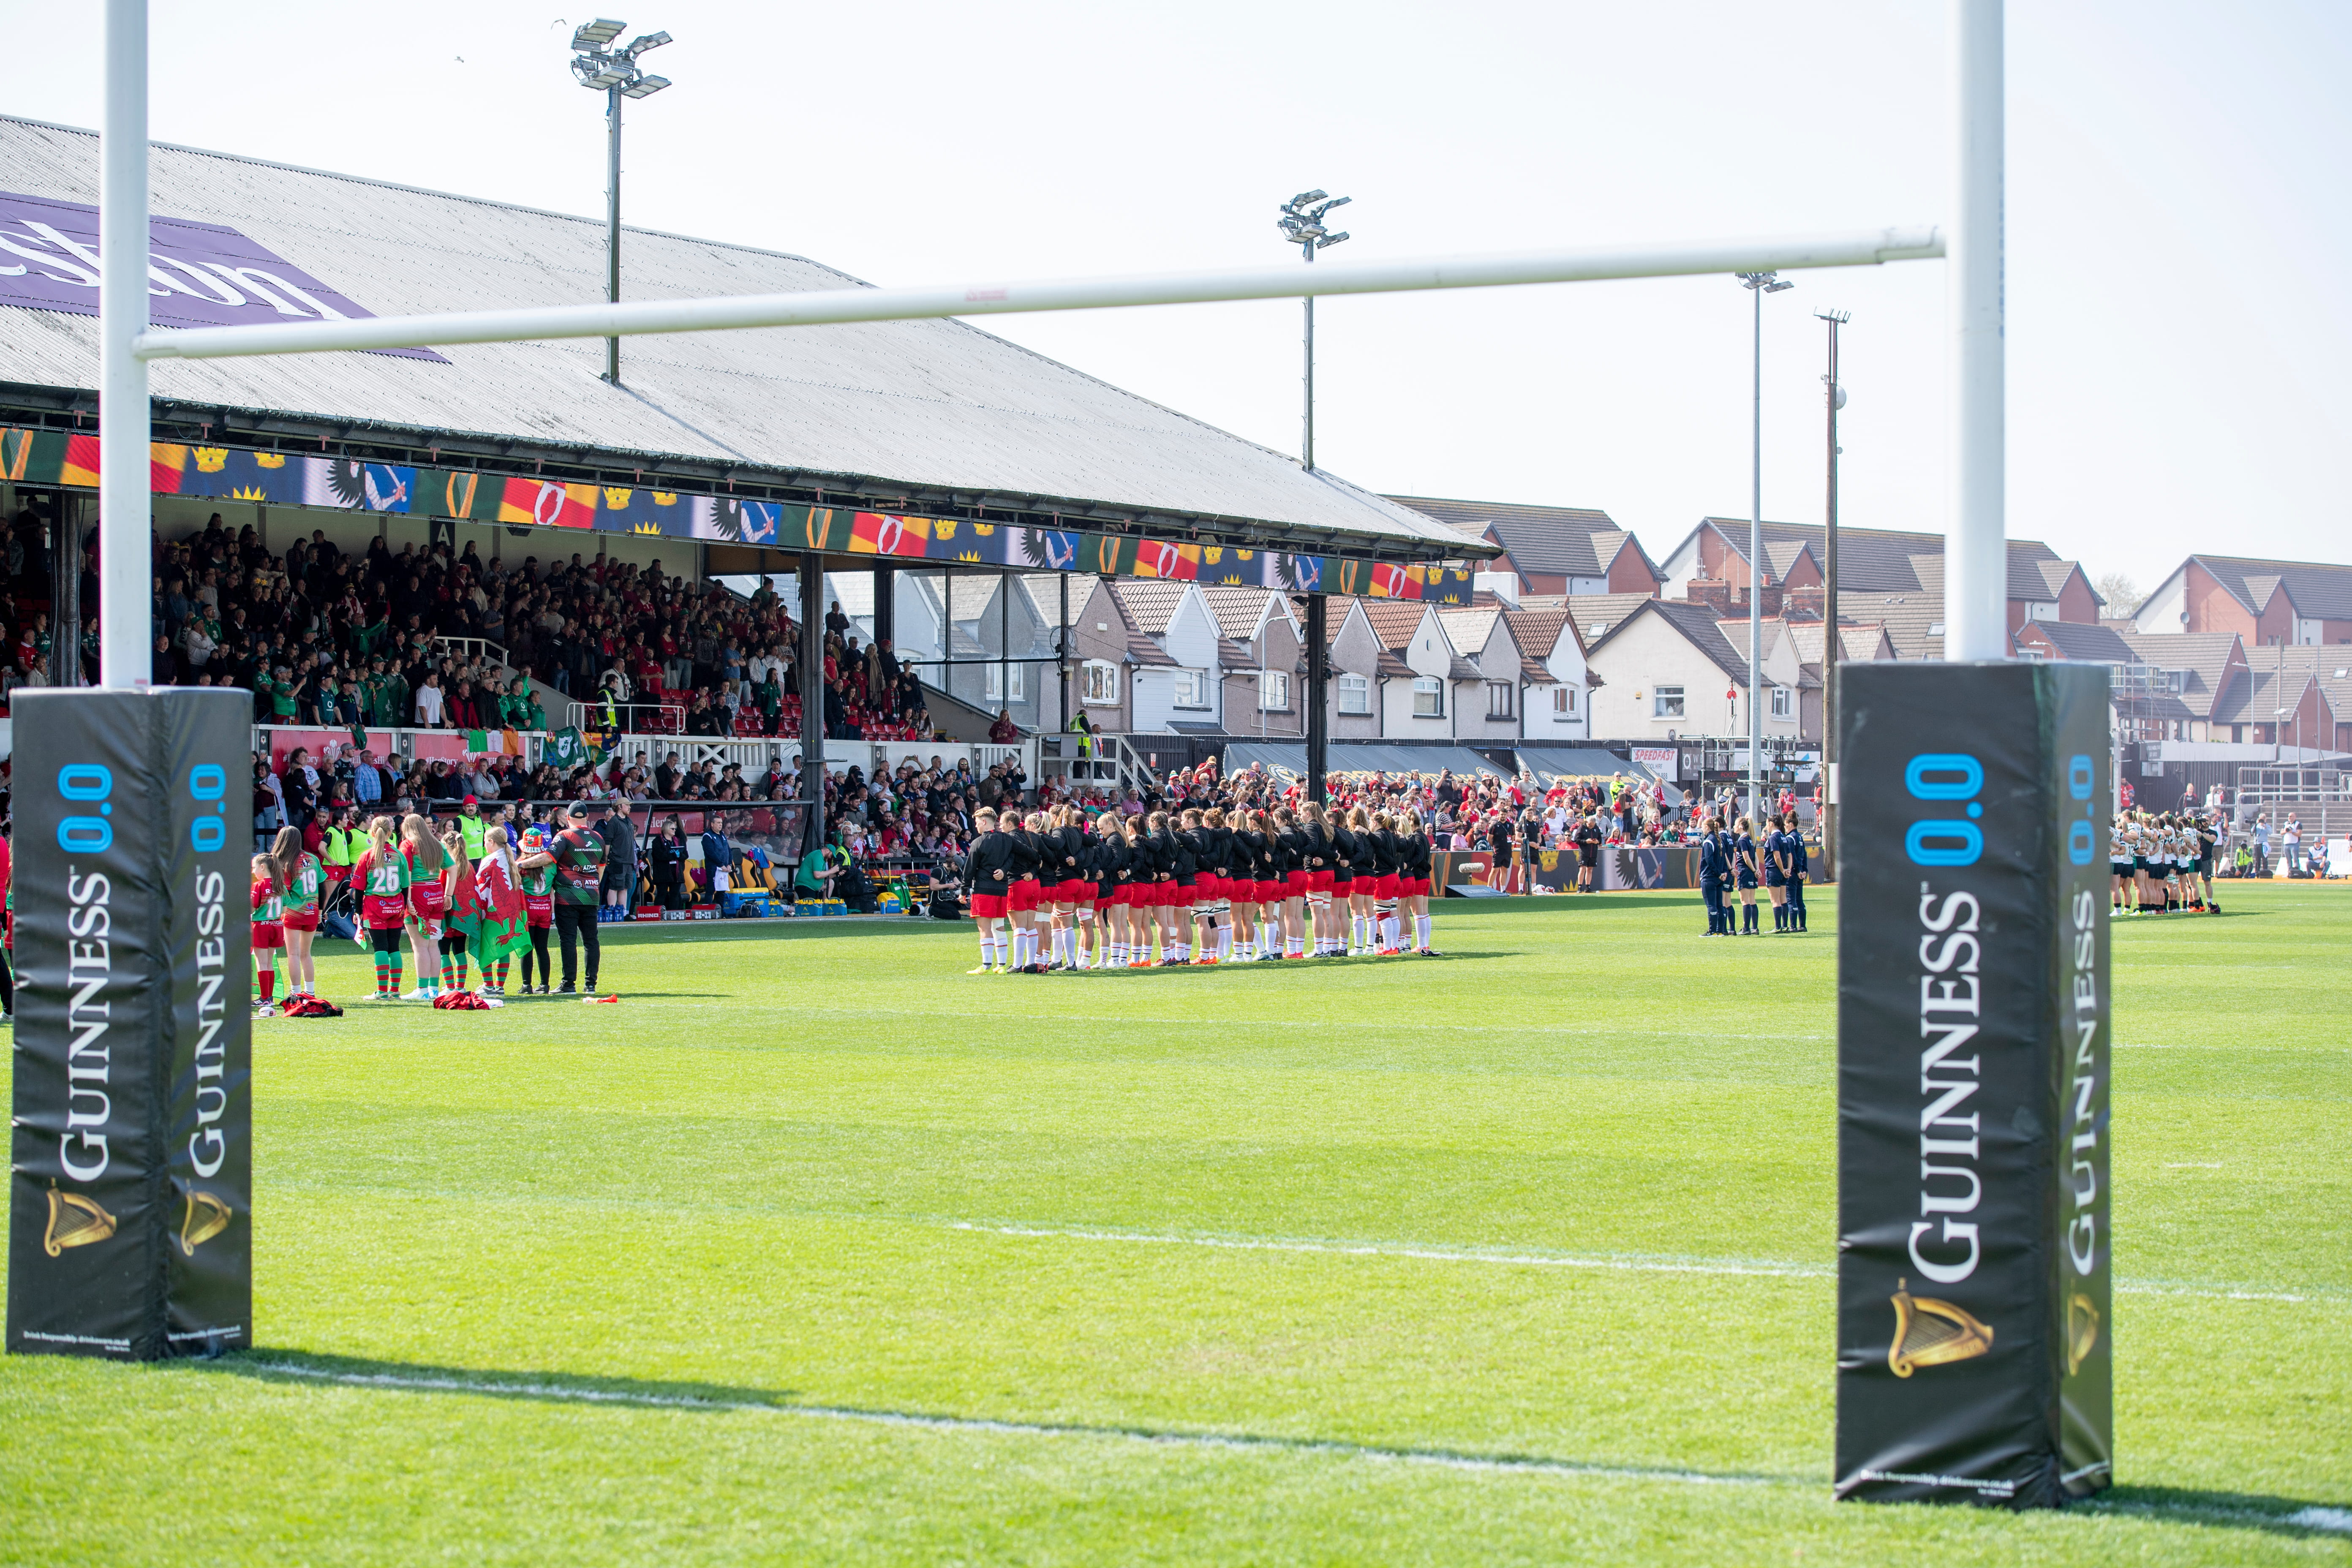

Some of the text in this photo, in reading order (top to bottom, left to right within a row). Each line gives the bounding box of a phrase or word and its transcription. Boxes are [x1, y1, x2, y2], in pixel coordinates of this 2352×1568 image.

[0, 219, 353, 321] ston
[437, 523, 451, 546] A
[1635, 749, 1675, 761] SPEEDFAST
[1693, 754, 1727, 764] WTERN
[57, 763, 114, 854] 0.0
[267, 896, 282, 918] 11
[300, 869, 317, 895] 19
[373, 866, 399, 892] 25
[189, 763, 226, 1178] GUINNESS 0.0
[60, 873, 110, 1181] GUINNESS
[1904, 753, 1984, 1283] GUINNESS 0.0
[2067, 754, 2097, 1276] GUINNESS 0.0
